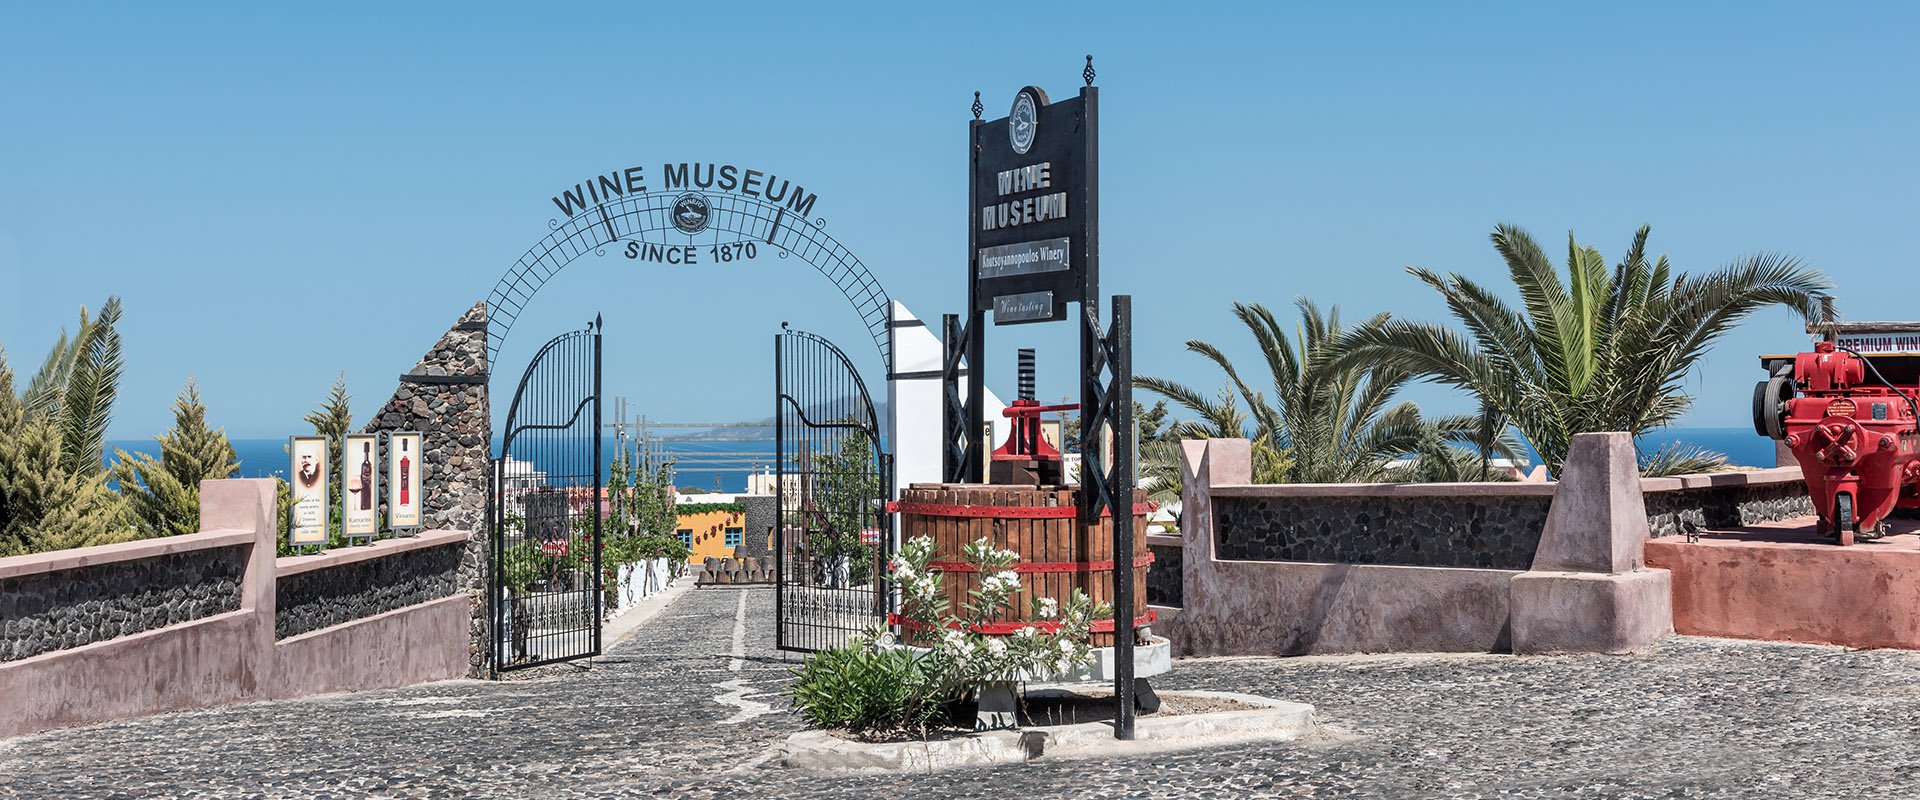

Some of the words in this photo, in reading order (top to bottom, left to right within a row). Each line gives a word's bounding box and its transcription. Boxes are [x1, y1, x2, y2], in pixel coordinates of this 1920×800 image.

[552, 166, 647, 217] WINE
[664, 162, 818, 218] MUSEUM
[997, 162, 1050, 196] WINE
[982, 192, 1067, 231] MUSEUM
[624, 241, 697, 264] SINCE
[710, 241, 757, 263] 1870
[1040, 246, 1065, 264] Winery
[1837, 337, 1892, 353] PREMIUM
[1896, 336, 1920, 351] WIN
